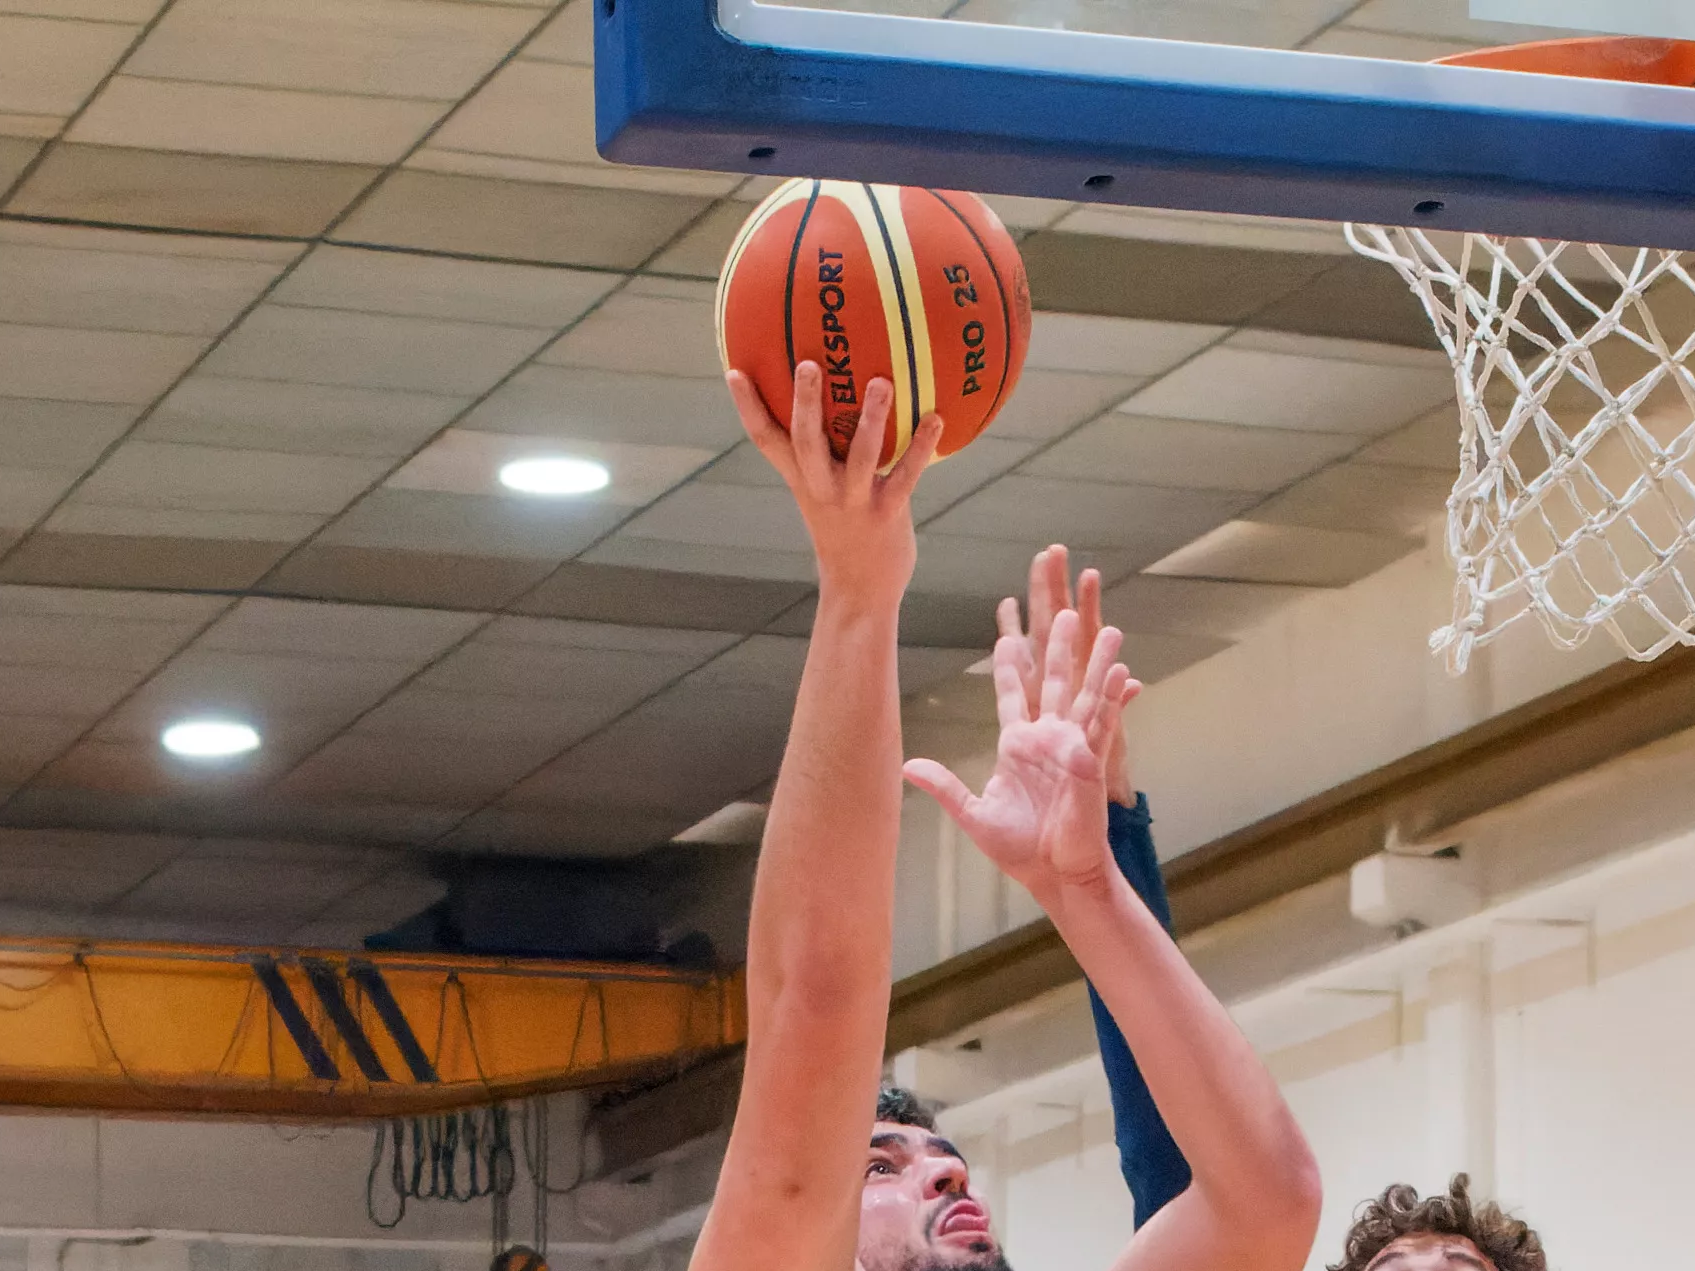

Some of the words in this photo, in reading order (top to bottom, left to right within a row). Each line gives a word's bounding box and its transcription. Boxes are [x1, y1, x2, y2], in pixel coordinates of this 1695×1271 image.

[943, 263, 979, 308] 25
[818, 248, 857, 405] ELKSPORT
[962, 319, 986, 398] PRO
